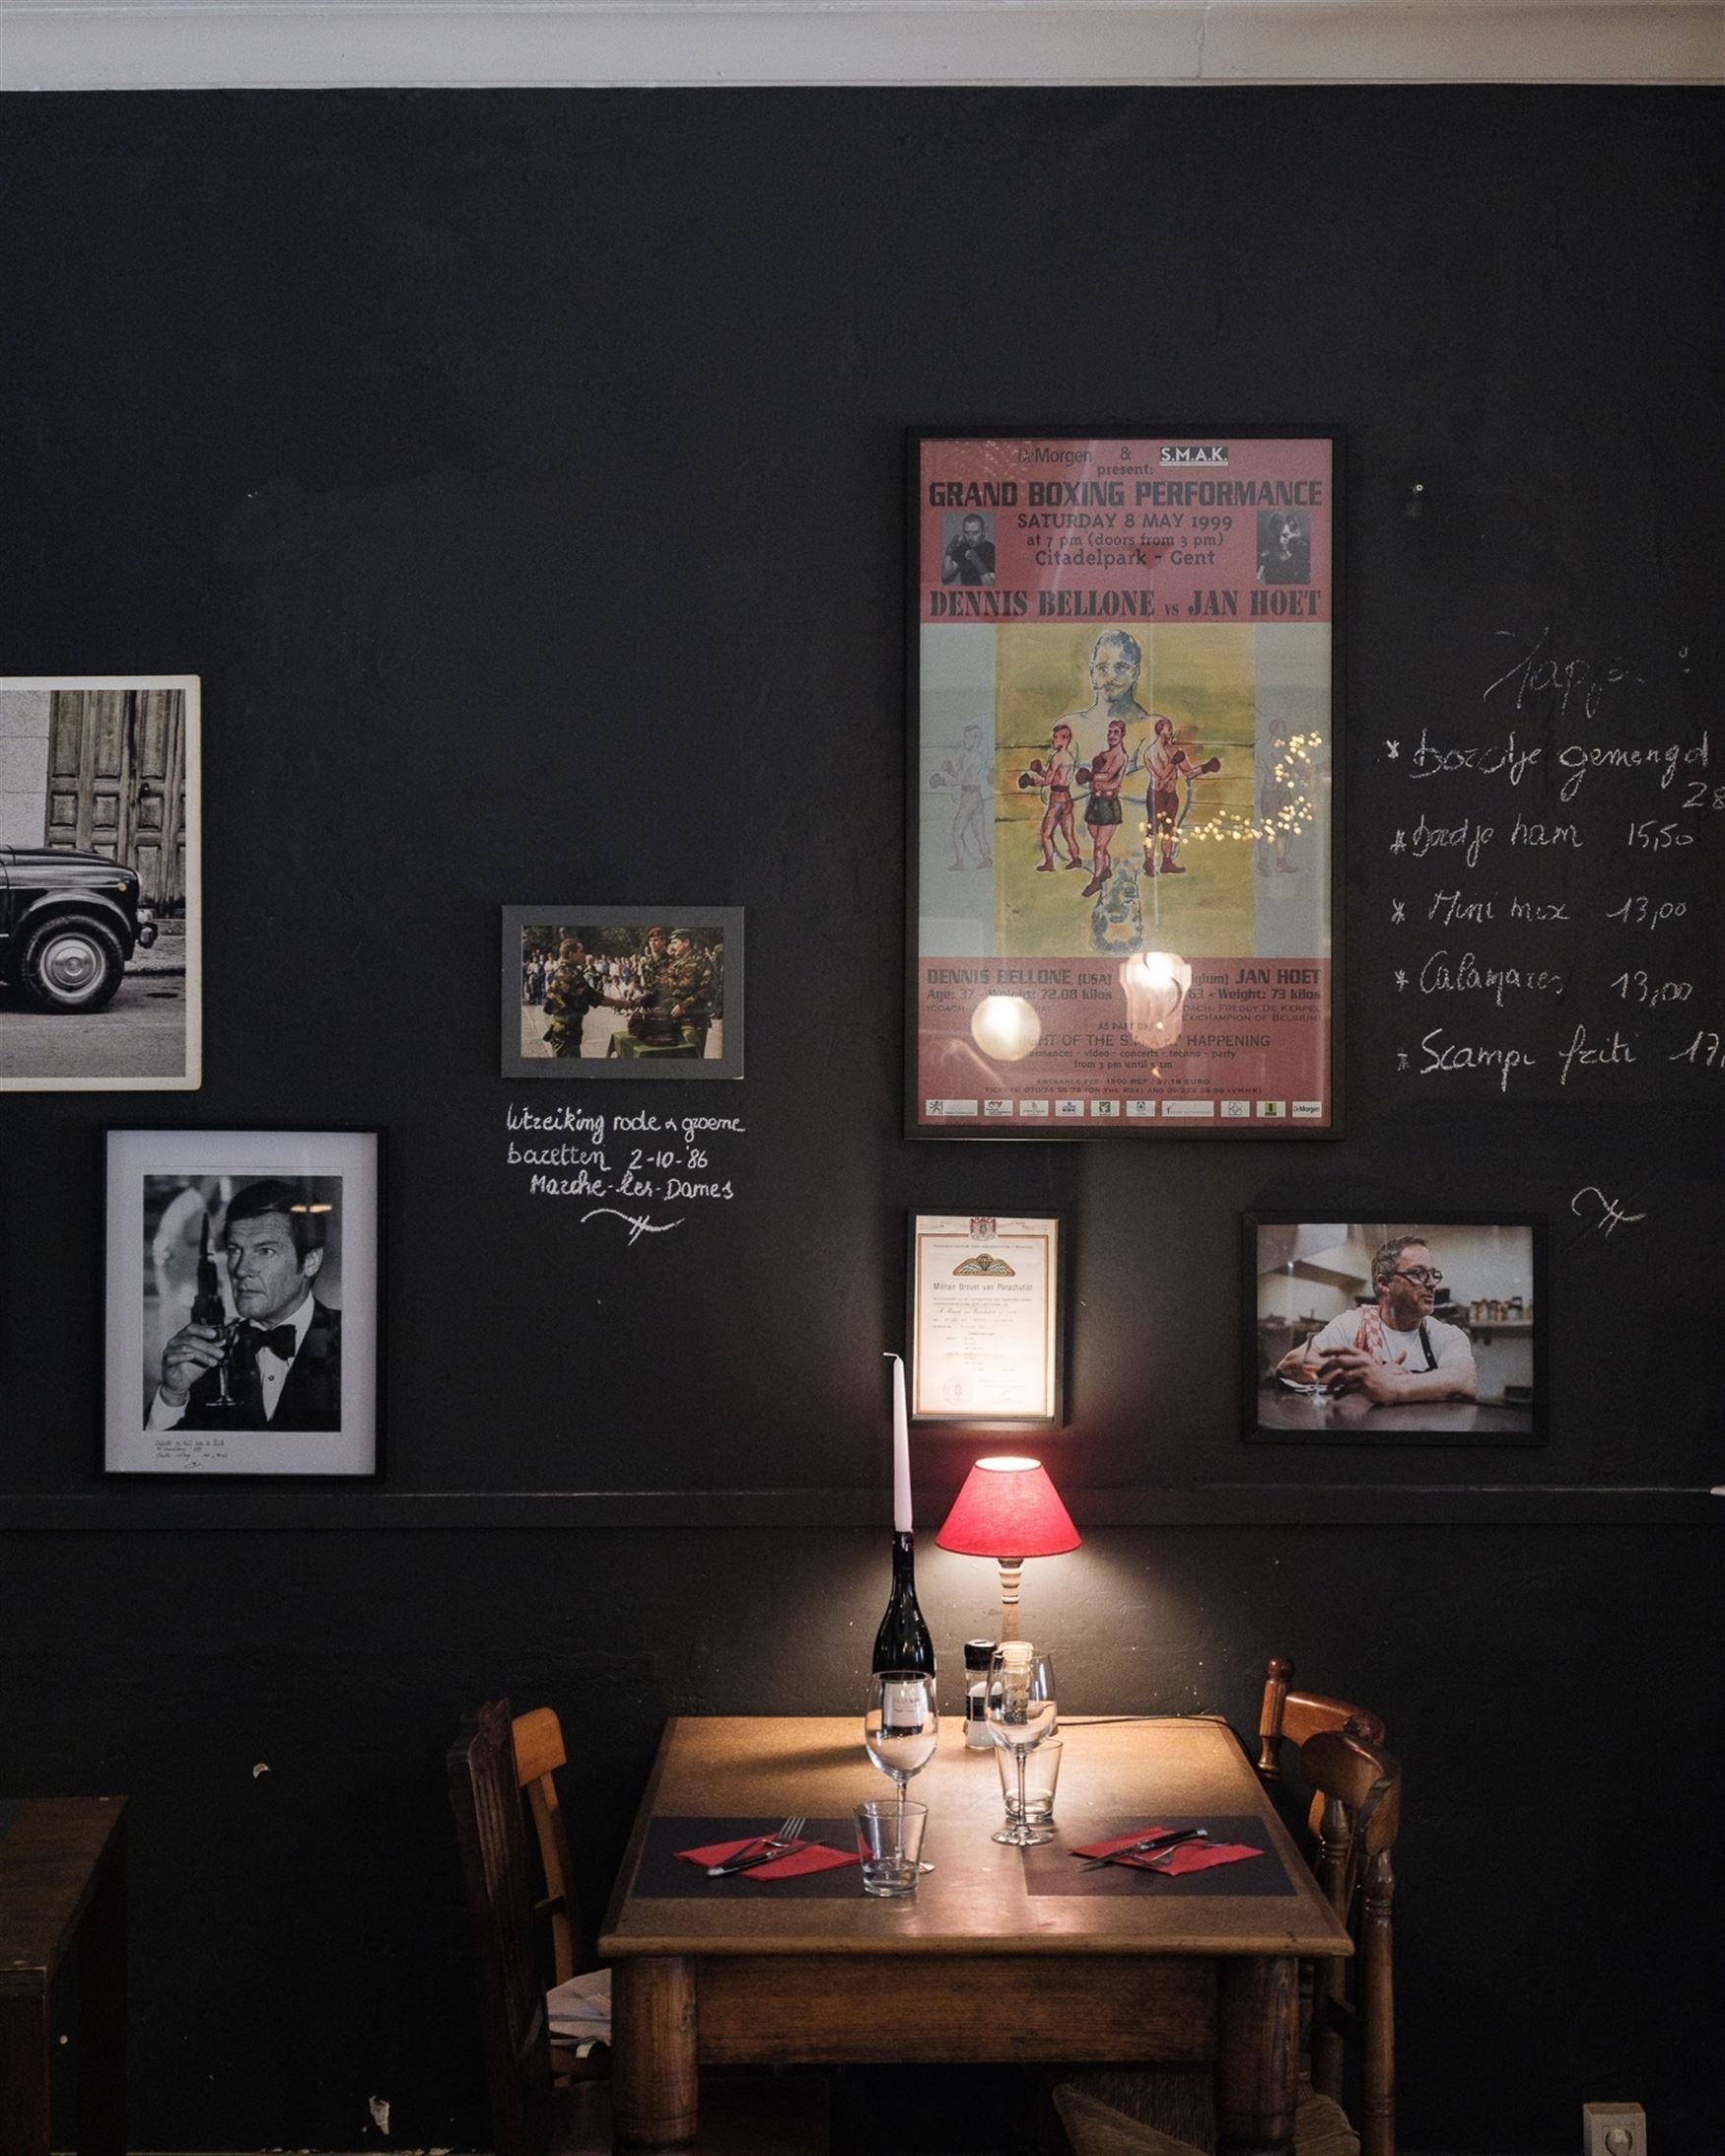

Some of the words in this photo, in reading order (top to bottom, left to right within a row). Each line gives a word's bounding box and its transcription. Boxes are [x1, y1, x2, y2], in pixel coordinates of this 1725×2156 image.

[1119, 447, 1132, 460] &
[1160, 447, 1228, 461] S.M.A.K.
[1097, 464, 1153, 478] present:
[930, 481, 1017, 507] GRAND
[1028, 481, 1125, 506] BOXING
[1136, 481, 1322, 506] PERFORMANCE
[1017, 514, 1116, 529] SATURDAY
[1125, 514, 1136, 529] 8
[1142, 514, 1184, 529] MAY
[1192, 516, 1233, 531] 1999
[1026, 535, 1041, 547] at
[1044, 536, 1054, 548] 7
[1060, 537, 1083, 549] pm
[1087, 532, 1136, 548] (doors
[1139, 533, 1174, 547] from
[1180, 536, 1189, 549] 3
[1194, 533, 1224, 549] pm)
[1035, 549, 1146, 569] Citadelpark
[1170, 551, 1215, 565] Gent
[931, 591, 1028, 616] DENNIS
[1038, 591, 1154, 616] BELLONE
[1188, 591, 1237, 616] JAN
[1250, 591, 1321, 616] HOET
[1511, 813, 1583, 848] ham
[1628, 820, 1693, 852] 15,50
[1428, 890, 1494, 927] Mini
[1510, 896, 1571, 923] mix
[1607, 895, 1687, 930] 13,00
[927, 969, 990, 985] DENNIS
[997, 969, 1071, 985] BELLONE
[1077, 973, 1112, 986] (USA)
[1191, 973, 1229, 986] lgium)
[1235, 969, 1270, 984] JAN
[1276, 969, 1321, 984] HOET
[927, 989, 954, 1002] Age:
[960, 989, 974, 1000] 37
[1042, 989, 1077, 1002] 72,08
[1081, 988, 1113, 1000] kilos
[1188, 989, 1205, 1000] 63
[1217, 989, 1266, 1002] Weight:
[1272, 989, 1286, 1000] 73
[1290, 988, 1321, 1000] kilos
[1611, 970, 1693, 1008] 13,00
[1062, 1035, 1081, 1047] OF
[1087, 1034, 1114, 1047] THE
[1187, 1035, 1271, 1047] HAPPENING
[1083, 1049, 1110, 1058] video
[1119, 1049, 1158, 1058] concerts
[1169, 1049, 1202, 1058] techno
[1211, 1050, 1237, 1060] party
[1419, 1028, 1536, 1092] Scampi
[1073, 1060, 1096, 1069] from
[1107, 1062, 1122, 1071] pm
[1125, 1060, 1147, 1069] until
[612, 1110, 661, 1131] rode
[681, 1116, 745, 1143] groene
